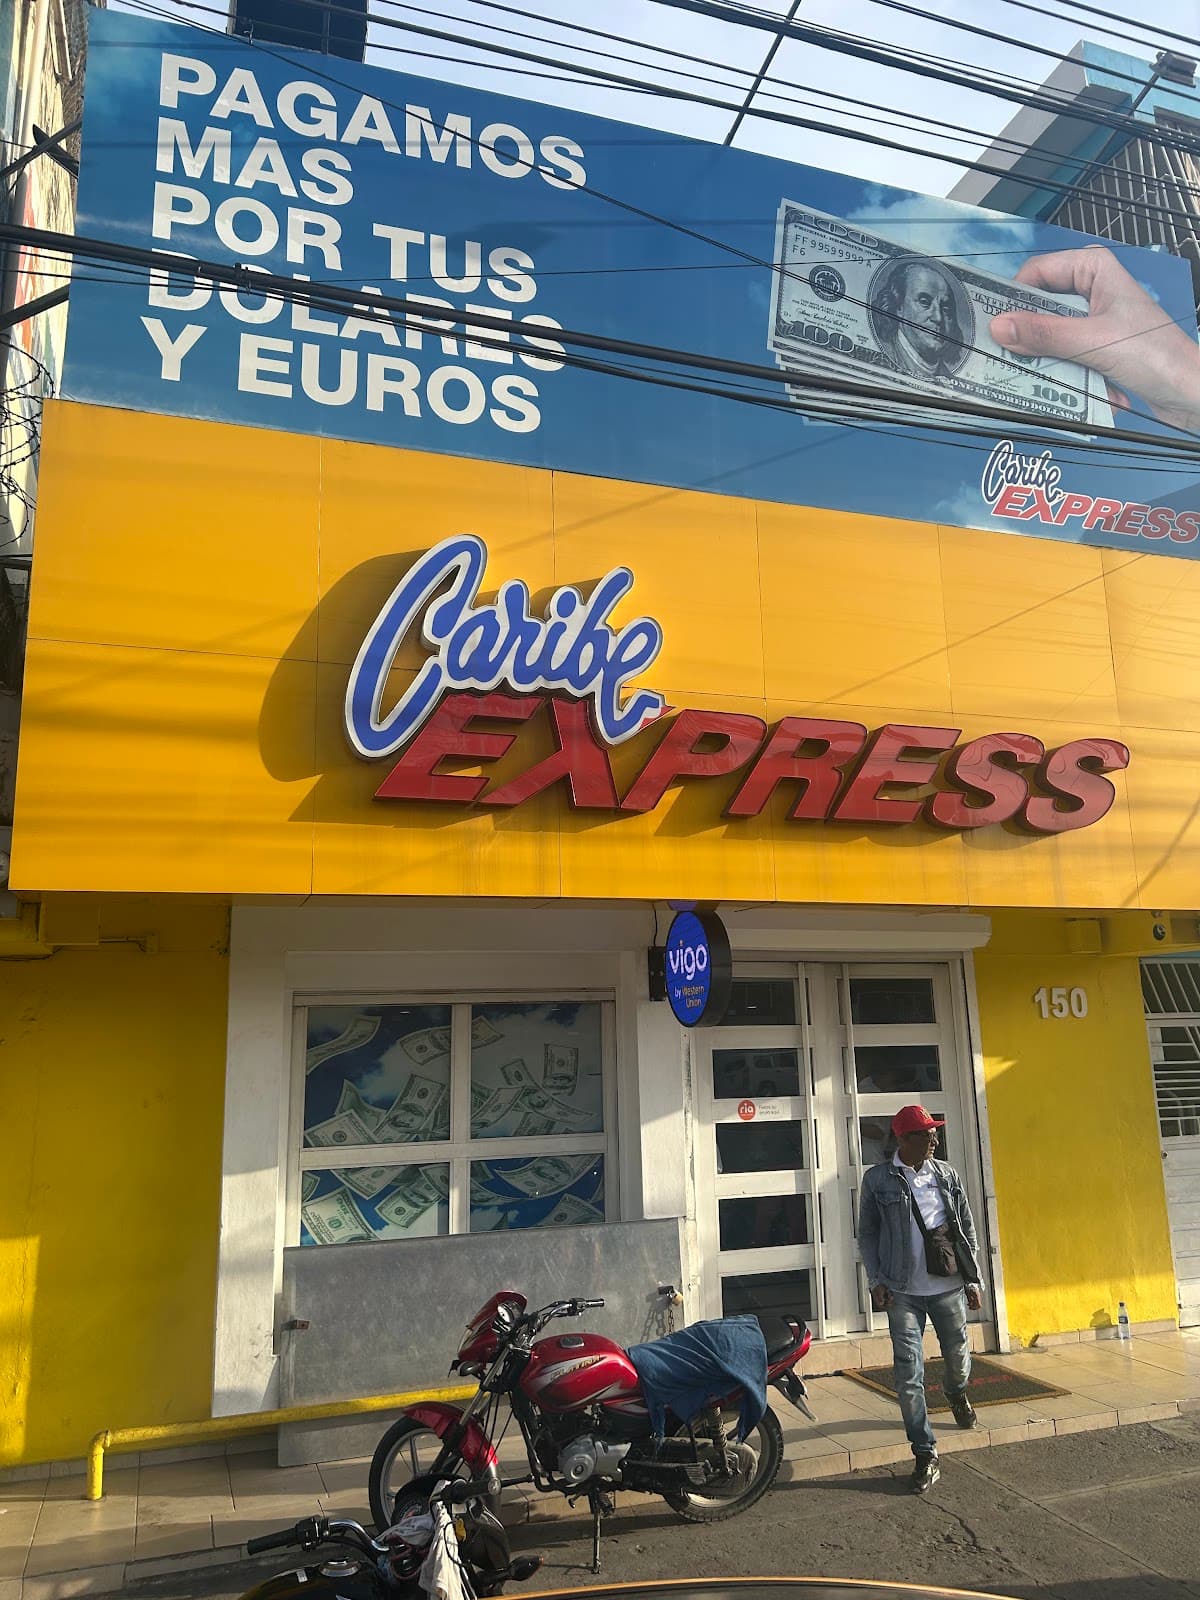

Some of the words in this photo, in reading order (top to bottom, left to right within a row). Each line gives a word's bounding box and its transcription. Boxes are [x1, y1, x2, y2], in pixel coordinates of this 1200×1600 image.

[160, 52, 588, 191] PAGAMOS
[155, 117, 354, 206] MAS
[152, 182, 343, 270] POR
[373, 222, 538, 303] TUS
[148, 248, 567, 372] DOLARES
[140, 316, 207, 382] Y
[238, 333, 542, 433] EUROS
[1031, 384, 1079, 408] 100
[982, 440, 1066, 504] Caribe
[992, 485, 1200, 543] EXPRESS
[343, 534, 668, 761] Caribe
[374, 692, 1131, 833] EXPRESS
[669, 940, 707, 981] vigo
[674, 986, 682, 999] by
[682, 985, 705, 997] Western
[685, 998, 702, 1009] Union
[1034, 987, 1088, 1019] 150
[740, 1102, 754, 1114] ria
